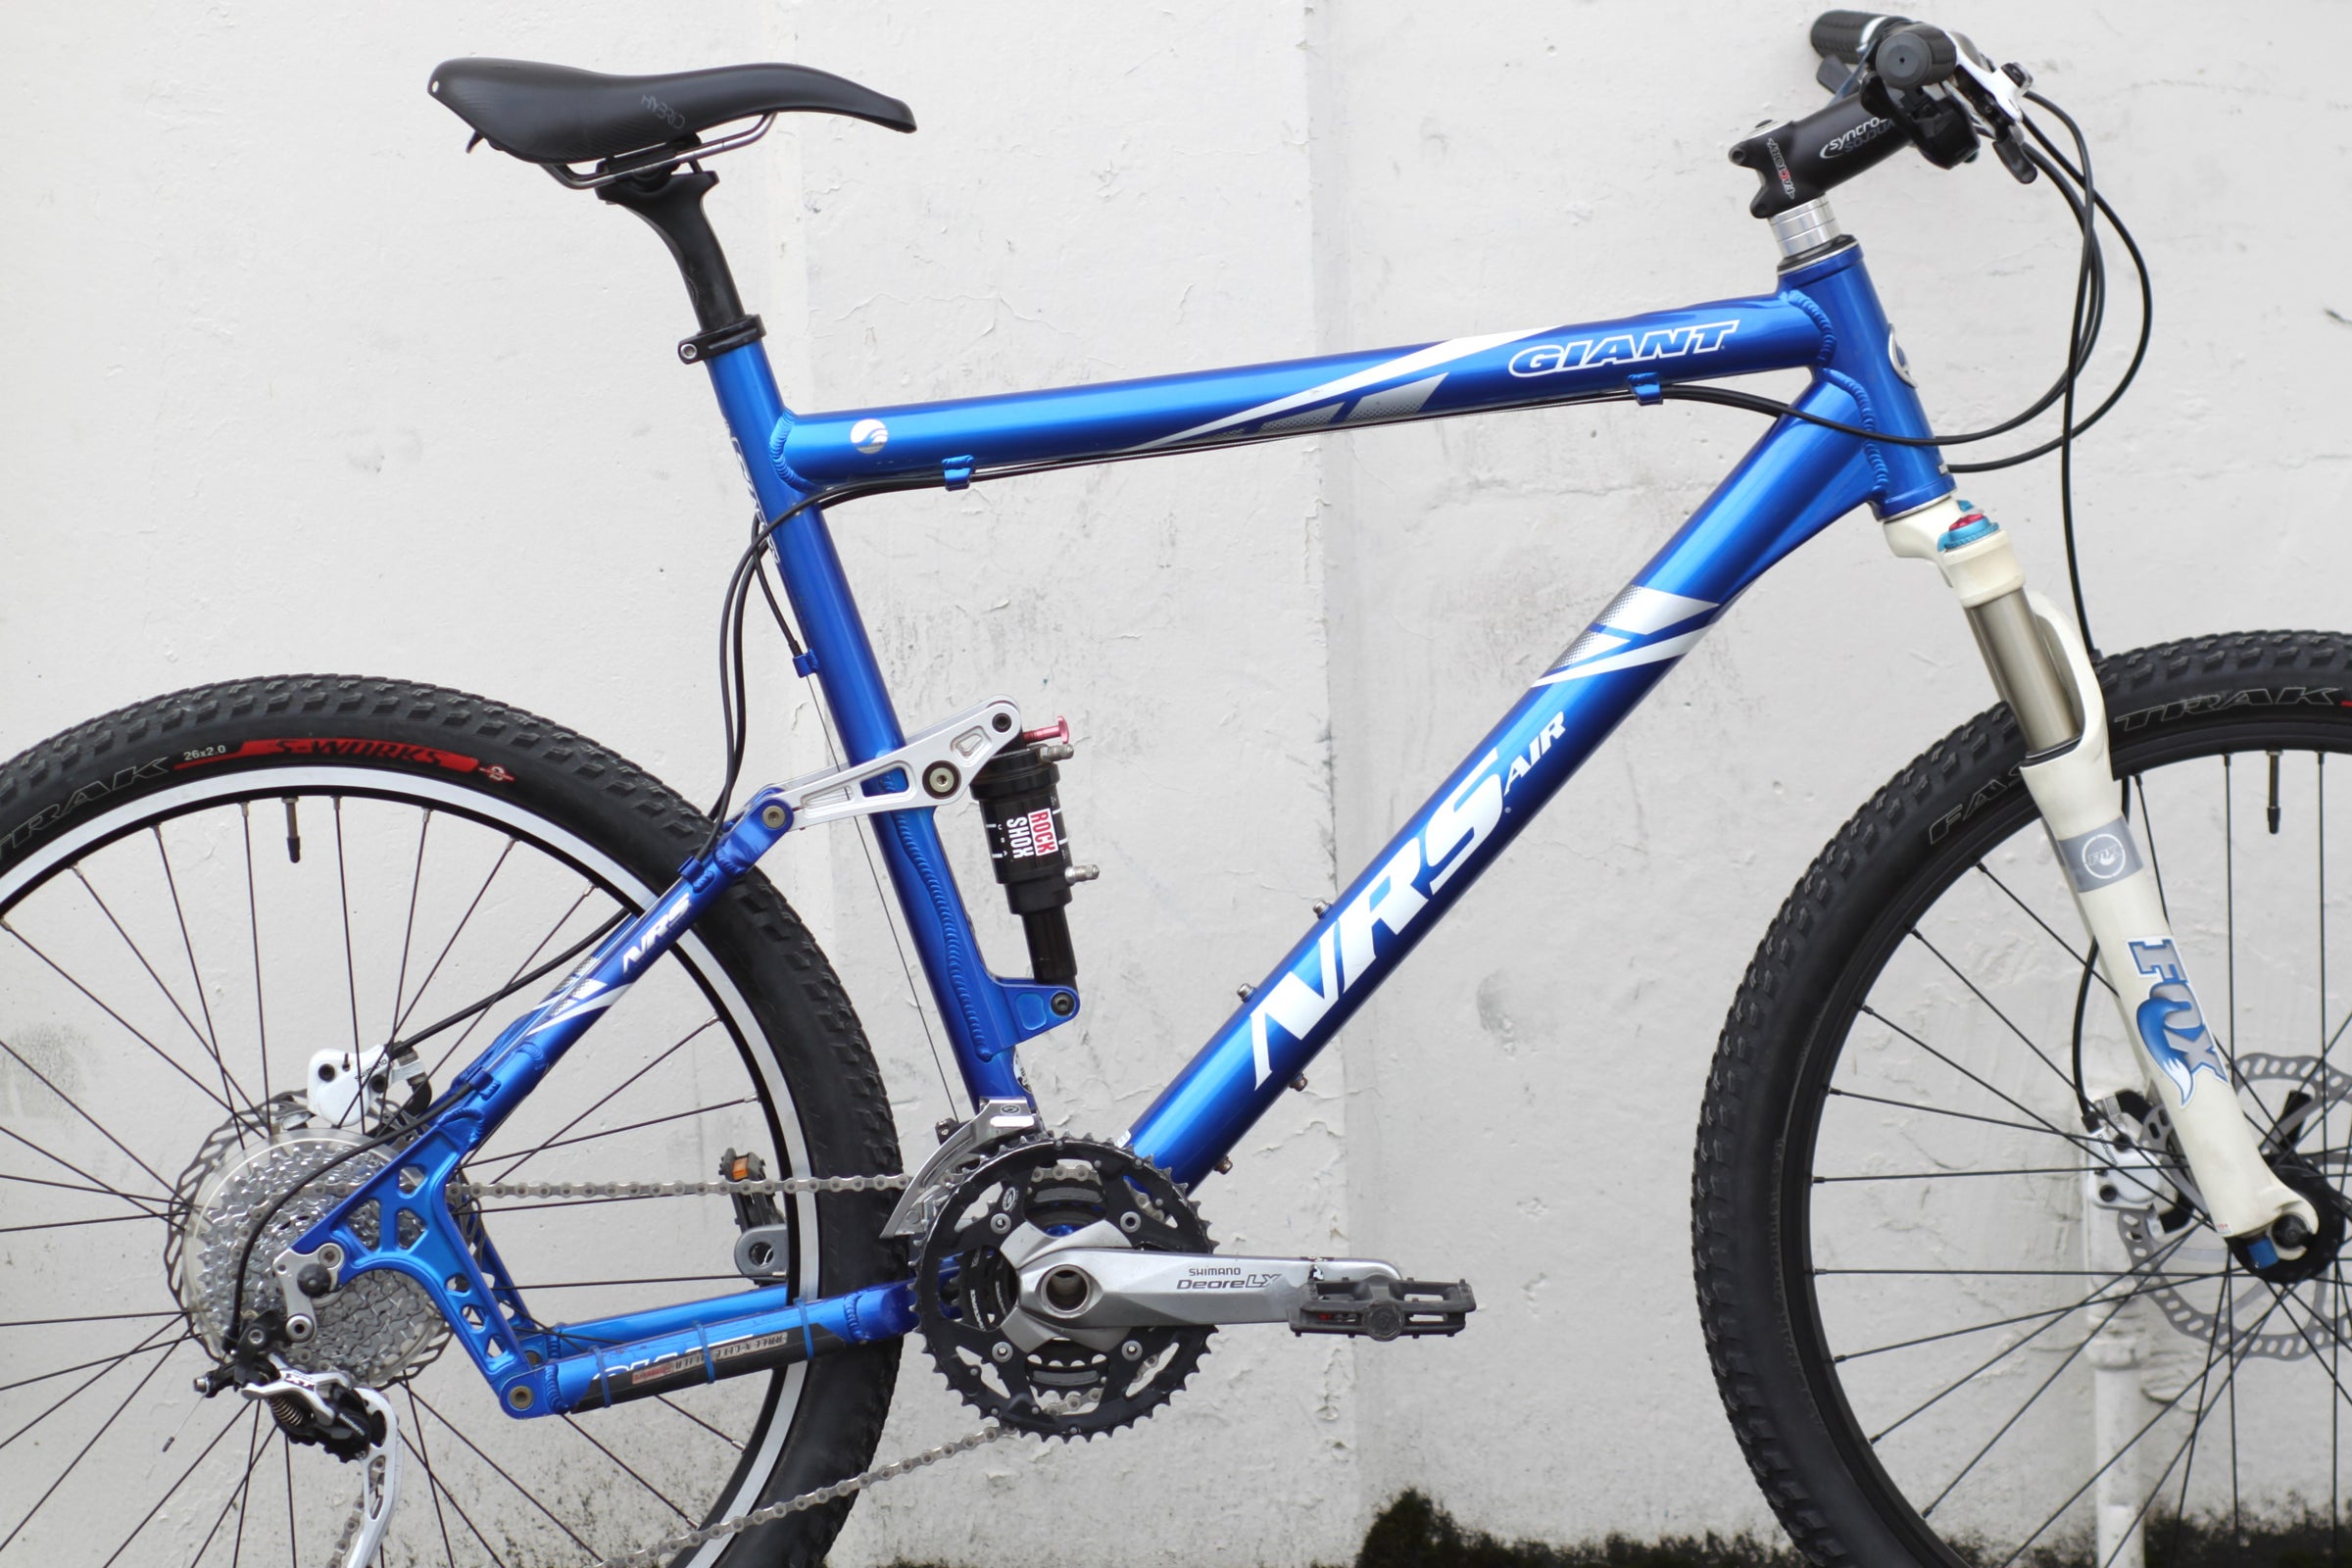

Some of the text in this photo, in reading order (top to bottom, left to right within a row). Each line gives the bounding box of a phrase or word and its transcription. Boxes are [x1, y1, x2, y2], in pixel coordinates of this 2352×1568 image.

[1829, 117, 1888, 151] syncro
[1767, 140, 1795, 198] FACTORY
[1508, 319, 1740, 377] GIANT
[2115, 686, 2340, 732] TRAK
[183, 744, 226, 761] 26x2.0
[272, 738, 444, 764] S-WORKS
[1006, 816, 1035, 858] SHOX
[1030, 810, 1056, 855] ROCK
[1250, 710, 1566, 1092] NRS AIR
[622, 893, 690, 973] NRS
[2128, 938, 2230, 1104] FOX
[354, 1058, 388, 1082] simno
[1189, 1267, 1242, 1277] SHIMANO
